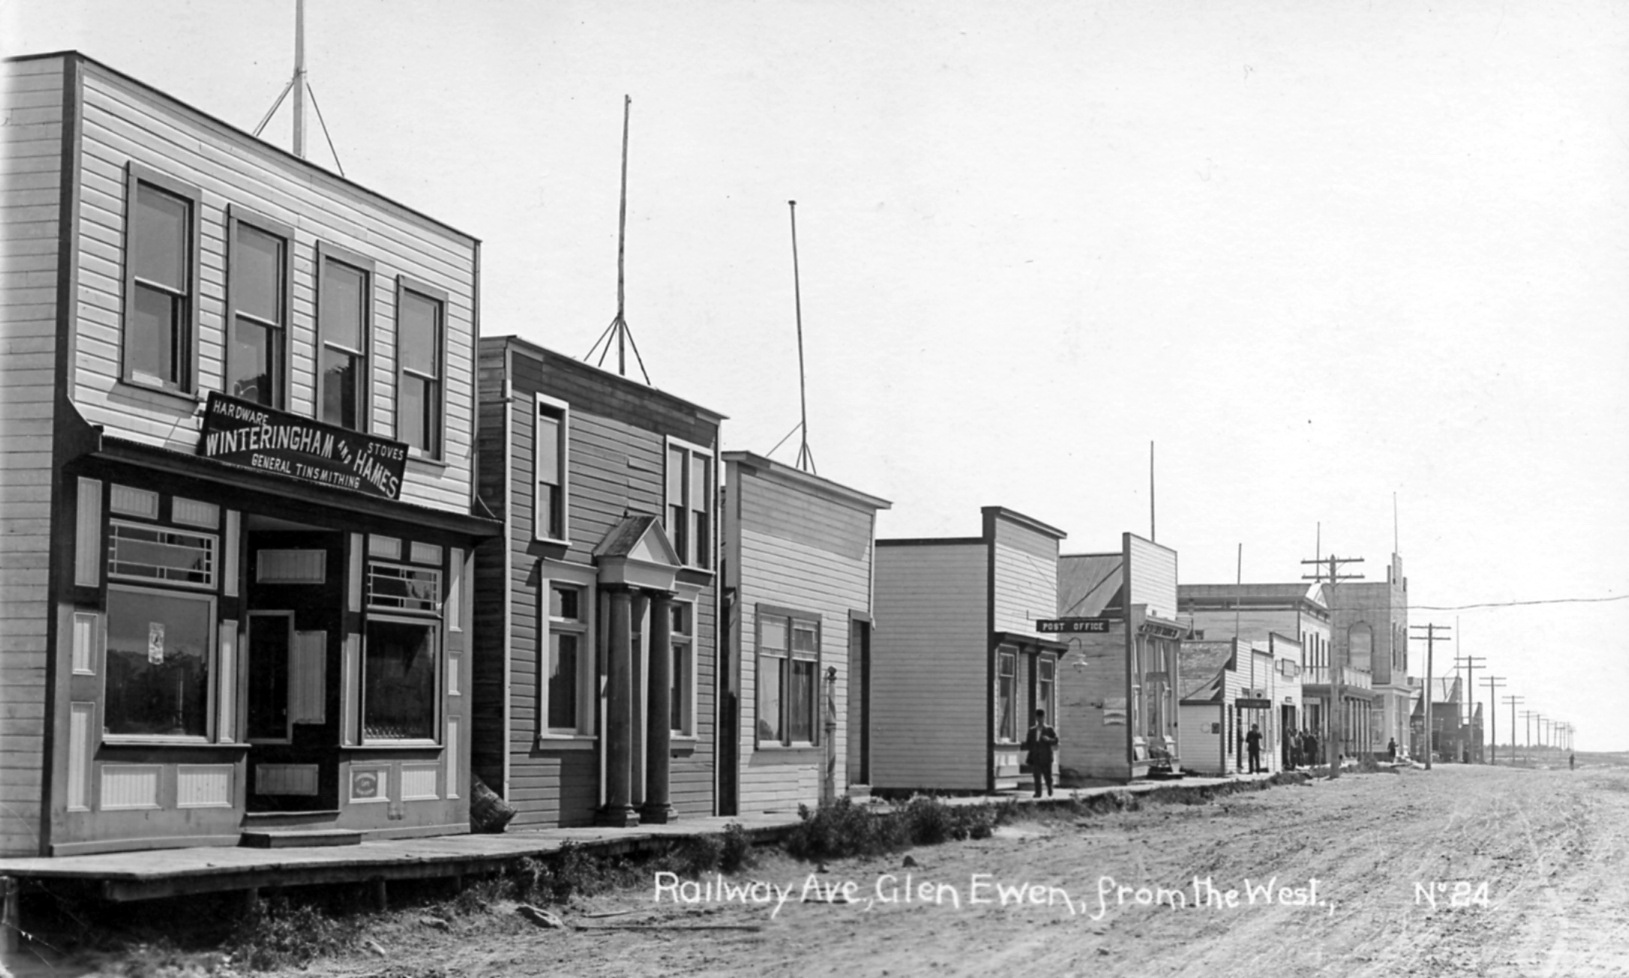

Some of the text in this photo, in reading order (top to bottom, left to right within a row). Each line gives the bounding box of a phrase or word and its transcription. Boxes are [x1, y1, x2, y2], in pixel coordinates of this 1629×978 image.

[213, 400, 269, 426] HARDWARE
[206, 425, 399, 499] WINTERINGHAM AND HAMES
[367, 442, 404, 461] STOVES
[251, 453, 361, 489] GENERAL TINSMITHING
[1042, 622, 1104, 631] POST OFFICE
